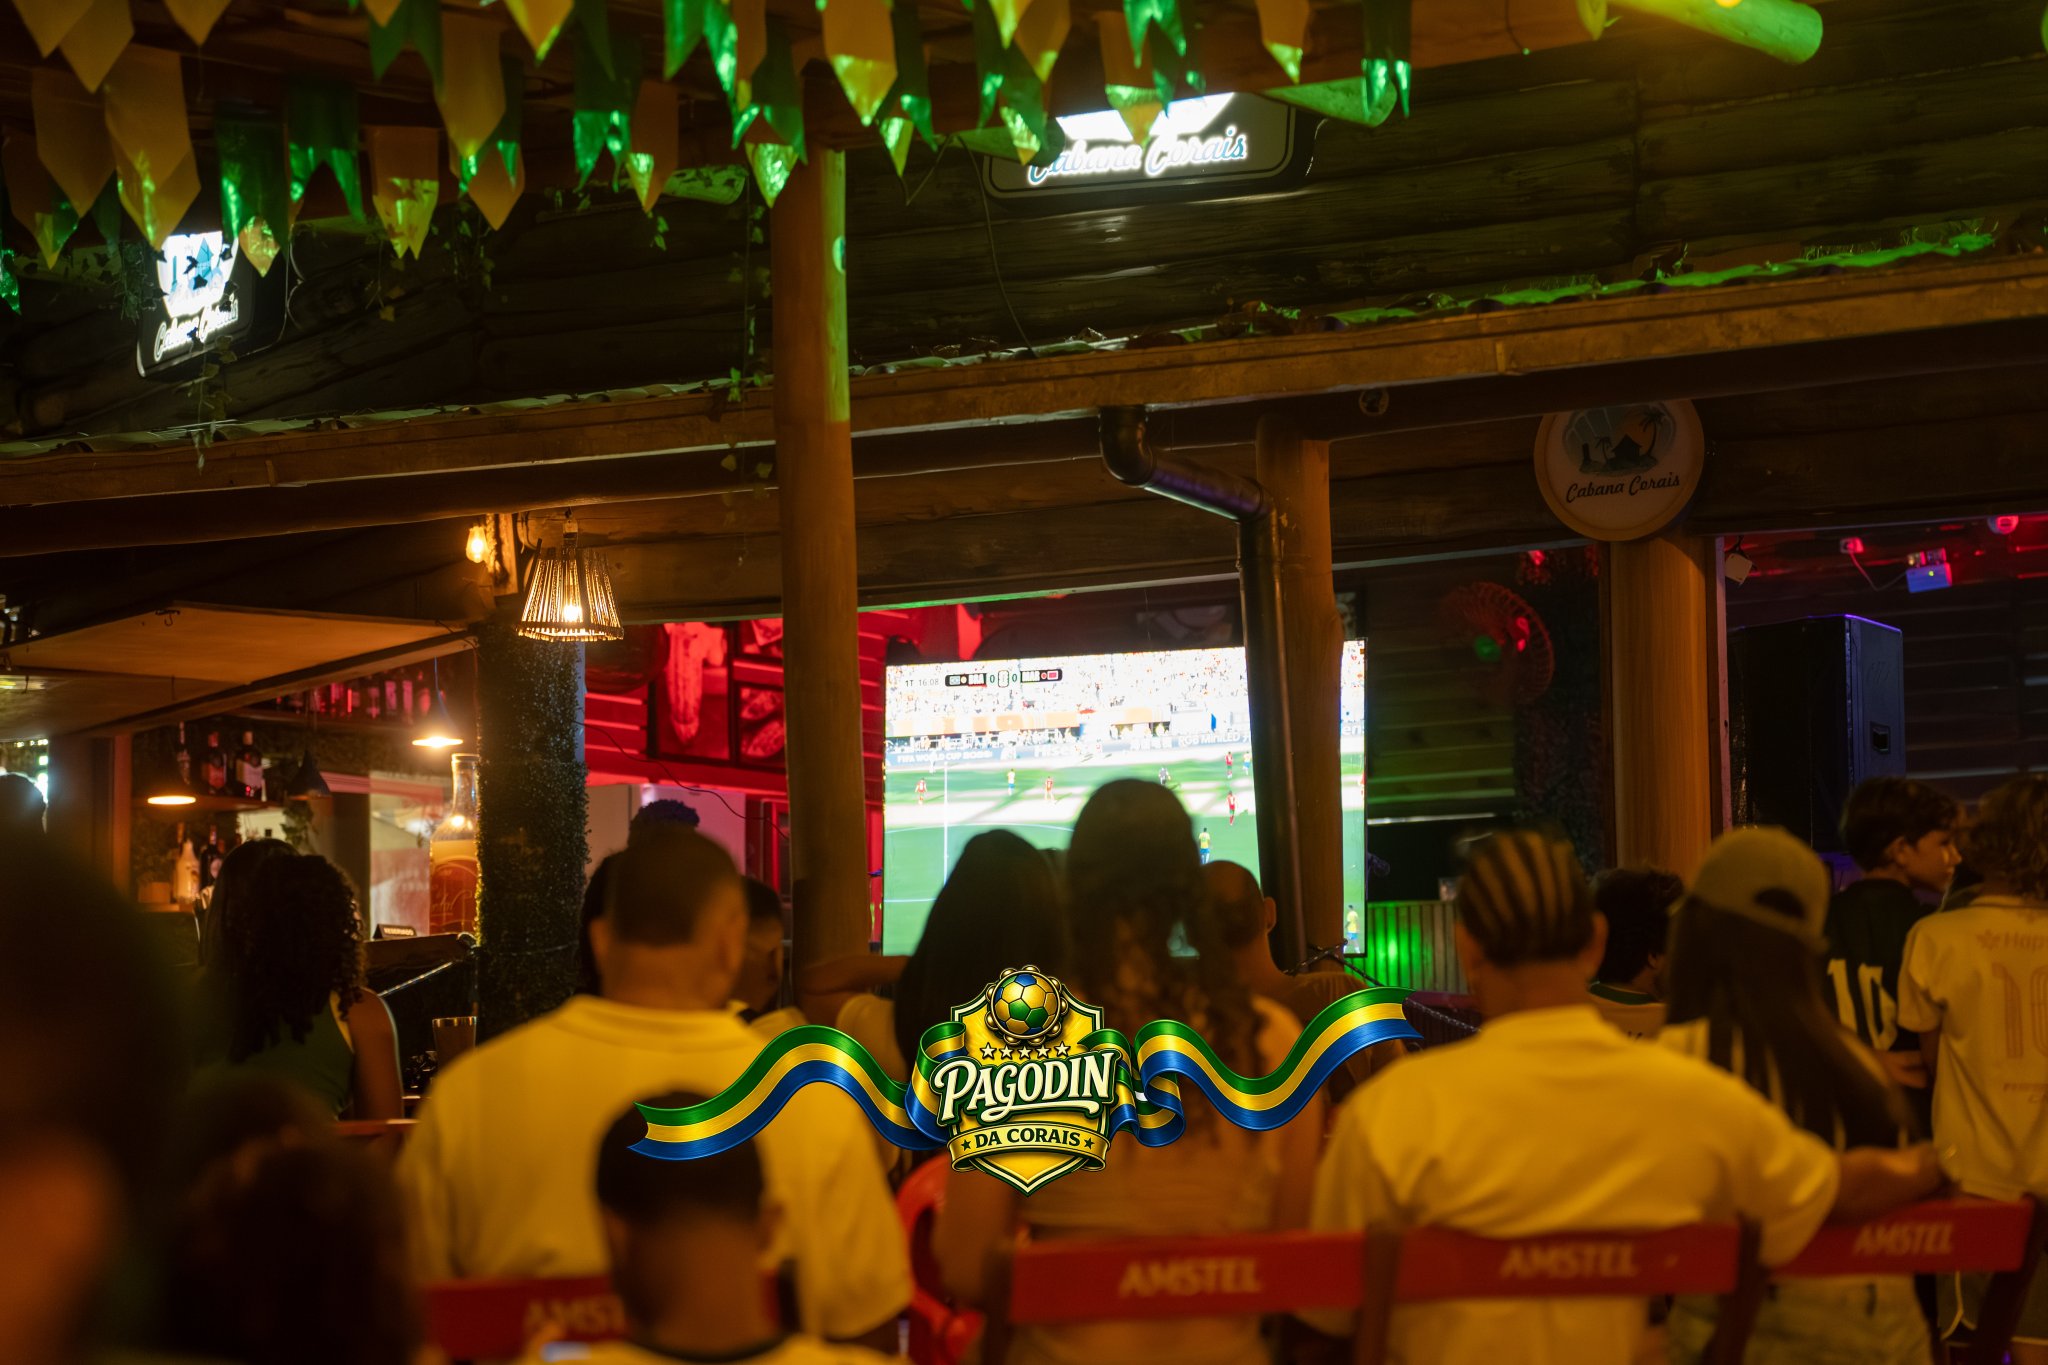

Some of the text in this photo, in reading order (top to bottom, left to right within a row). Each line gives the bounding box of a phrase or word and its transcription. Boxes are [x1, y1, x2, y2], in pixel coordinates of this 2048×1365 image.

[1145, 126, 1247, 177] Corais
[1565, 472, 1681, 503] Cabana Corais
[1827, 958, 1897, 1051] 10
[1853, 1222, 1955, 1255] AMSTEL
[1118, 1256, 1261, 1298] AMSTEL
[1499, 1241, 1637, 1279] AMSTEL
